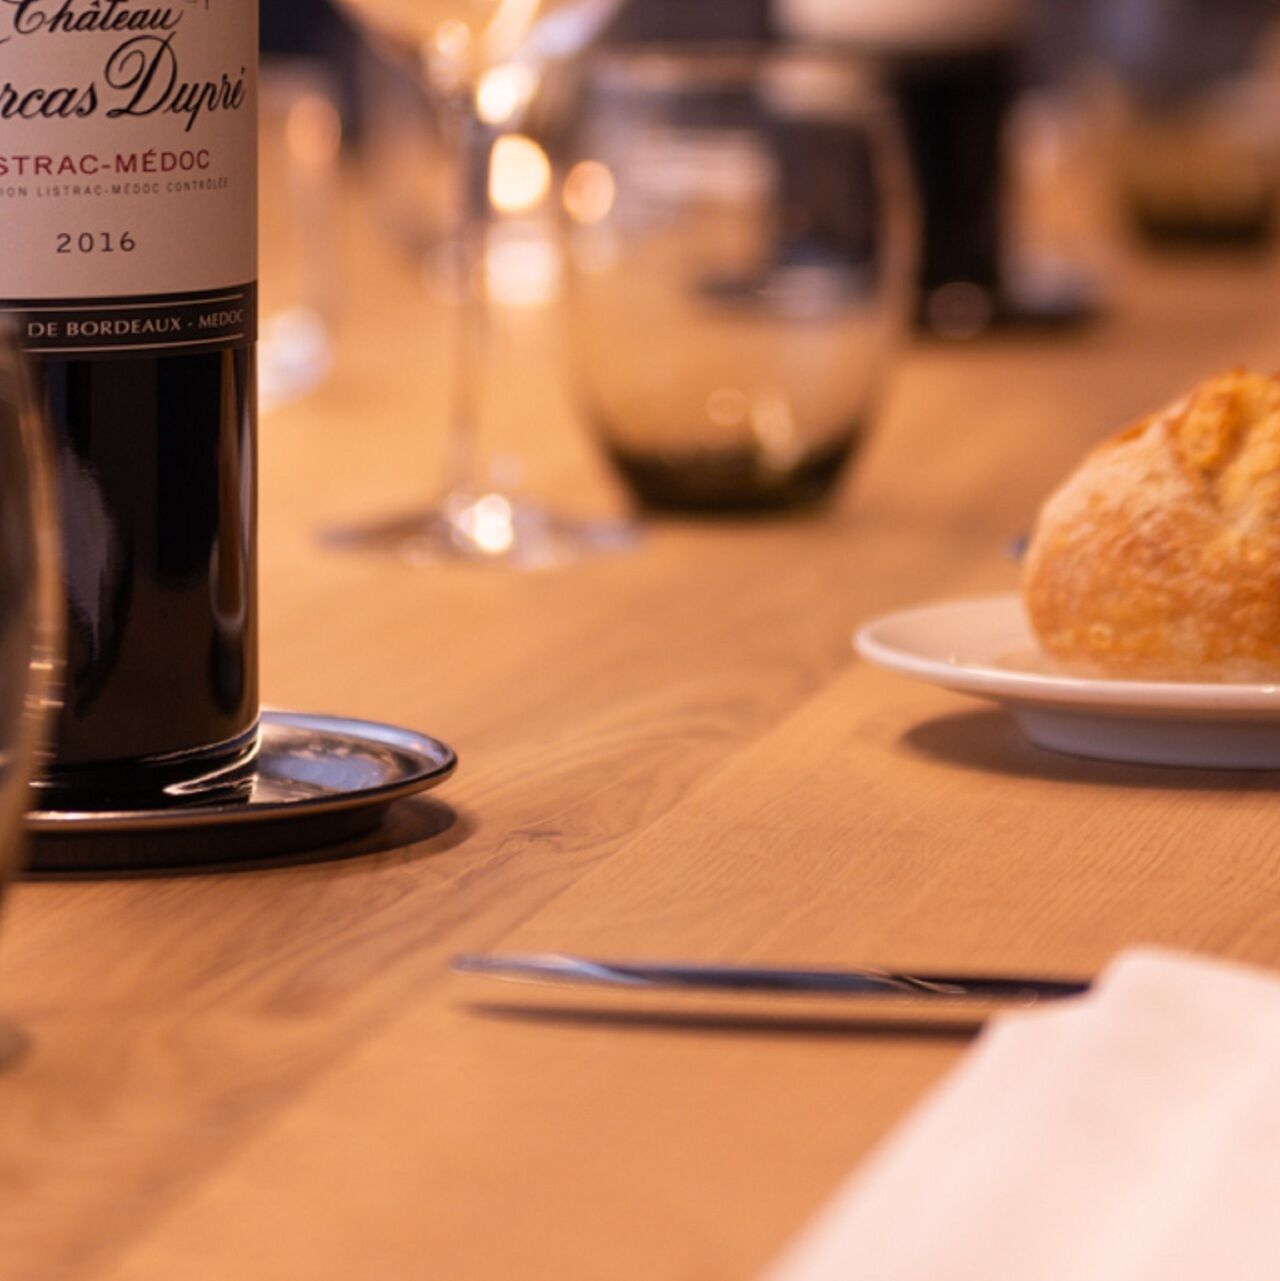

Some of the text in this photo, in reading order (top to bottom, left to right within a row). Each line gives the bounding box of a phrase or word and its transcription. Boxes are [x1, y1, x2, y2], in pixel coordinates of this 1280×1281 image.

[104, 31, 245, 132] Dupré
[56, 231, 137, 253] 2016
[27, 321, 58, 338] DE
[66, 318, 181, 336] BORDEAUX
